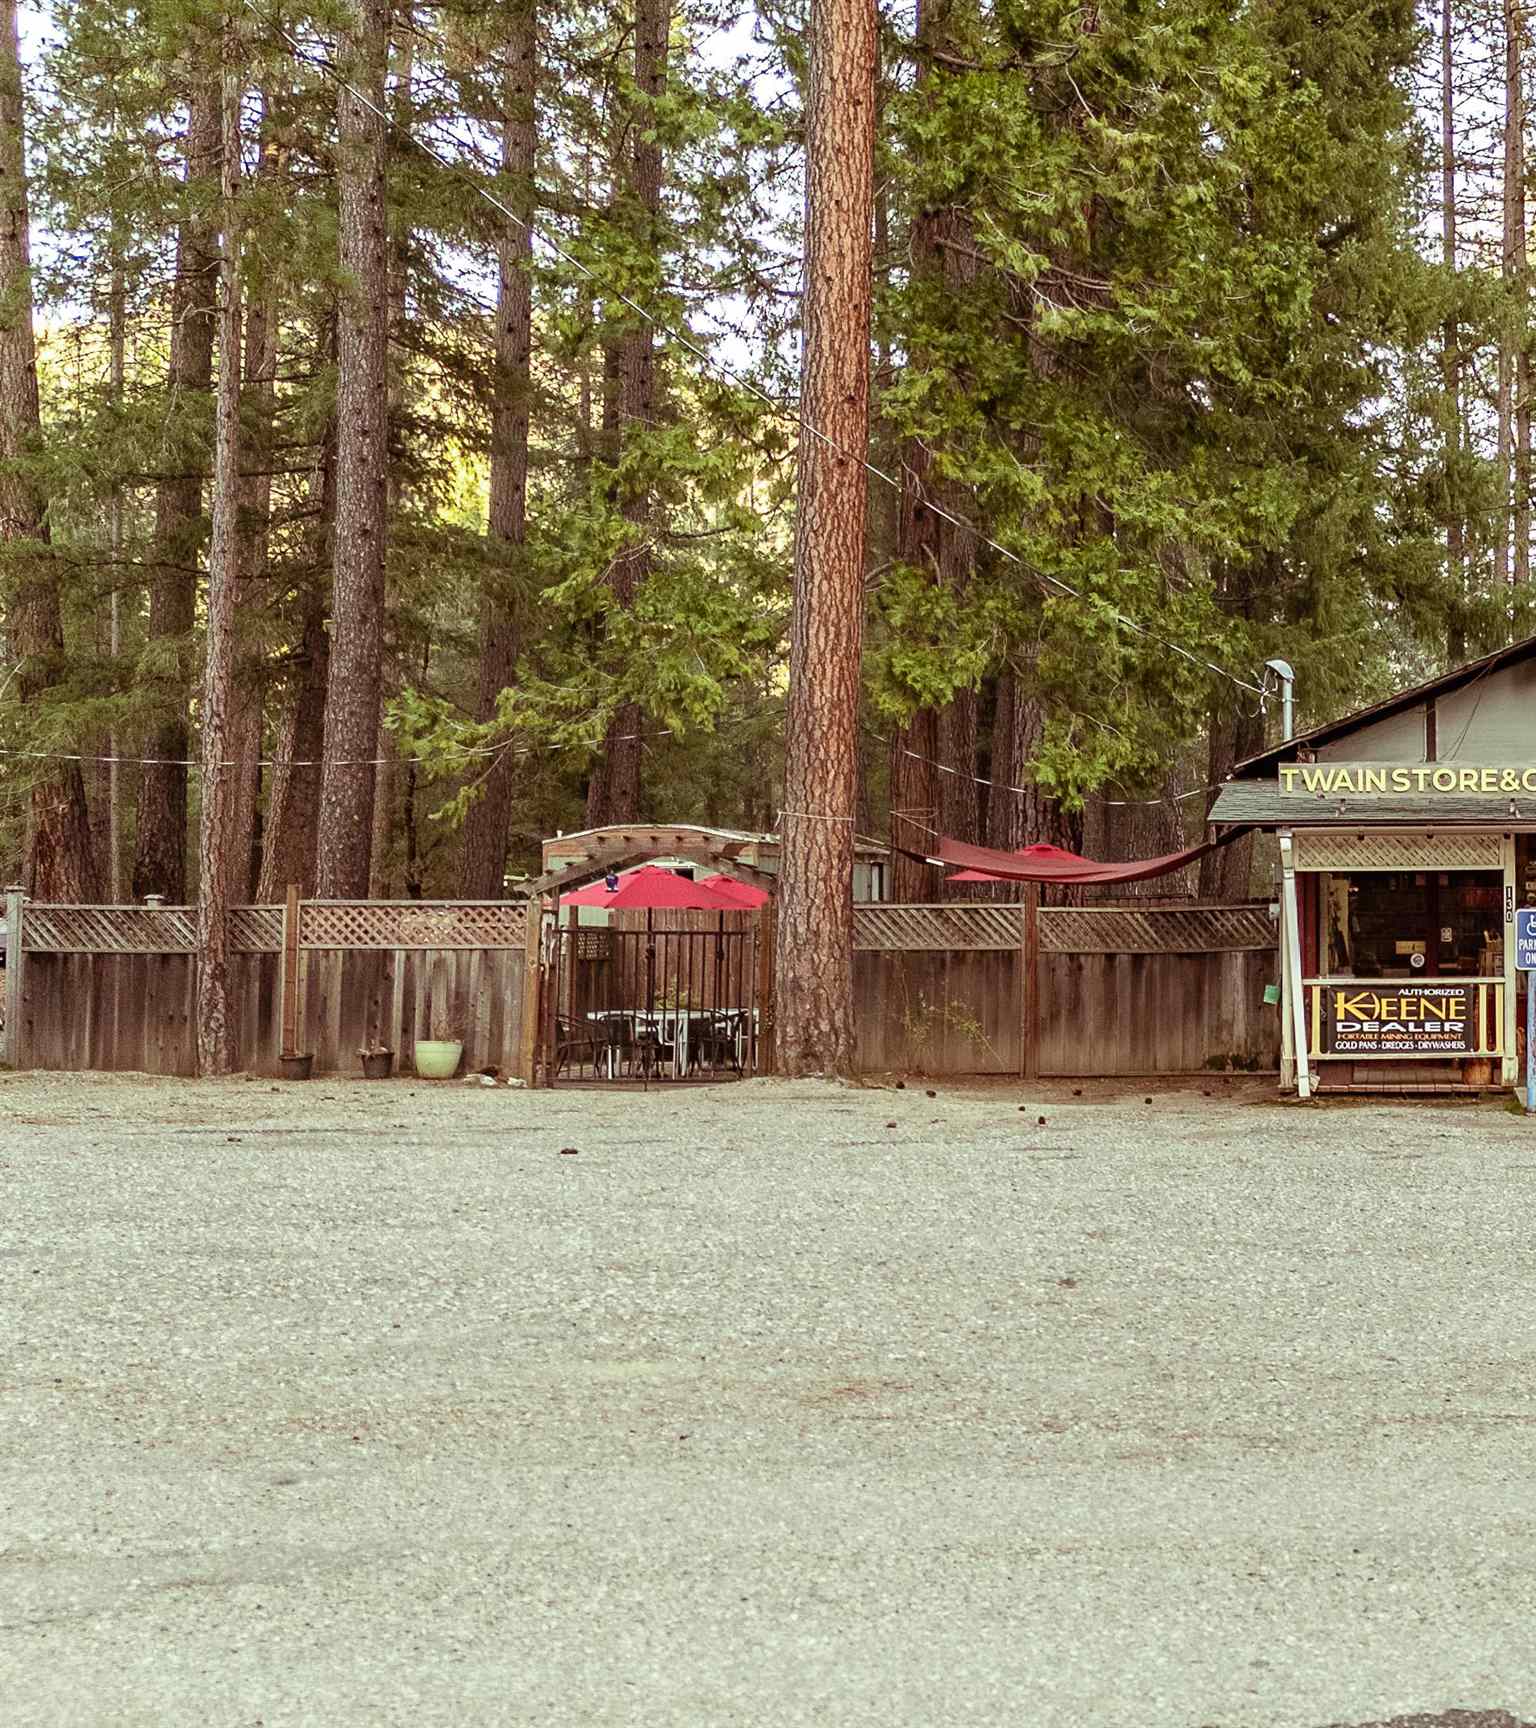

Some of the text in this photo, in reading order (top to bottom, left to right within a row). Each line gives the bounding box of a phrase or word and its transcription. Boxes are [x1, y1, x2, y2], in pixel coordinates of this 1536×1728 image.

[1280, 768, 1387, 793] TWAIN
[1398, 988, 1465, 996] AUTHORIZED
[1334, 991, 1467, 1020] KEENE
[1336, 1022, 1465, 1032] DEALER
[1335, 1041, 1465, 1049] GOLD PANS DREDGES DRYWASHERS
